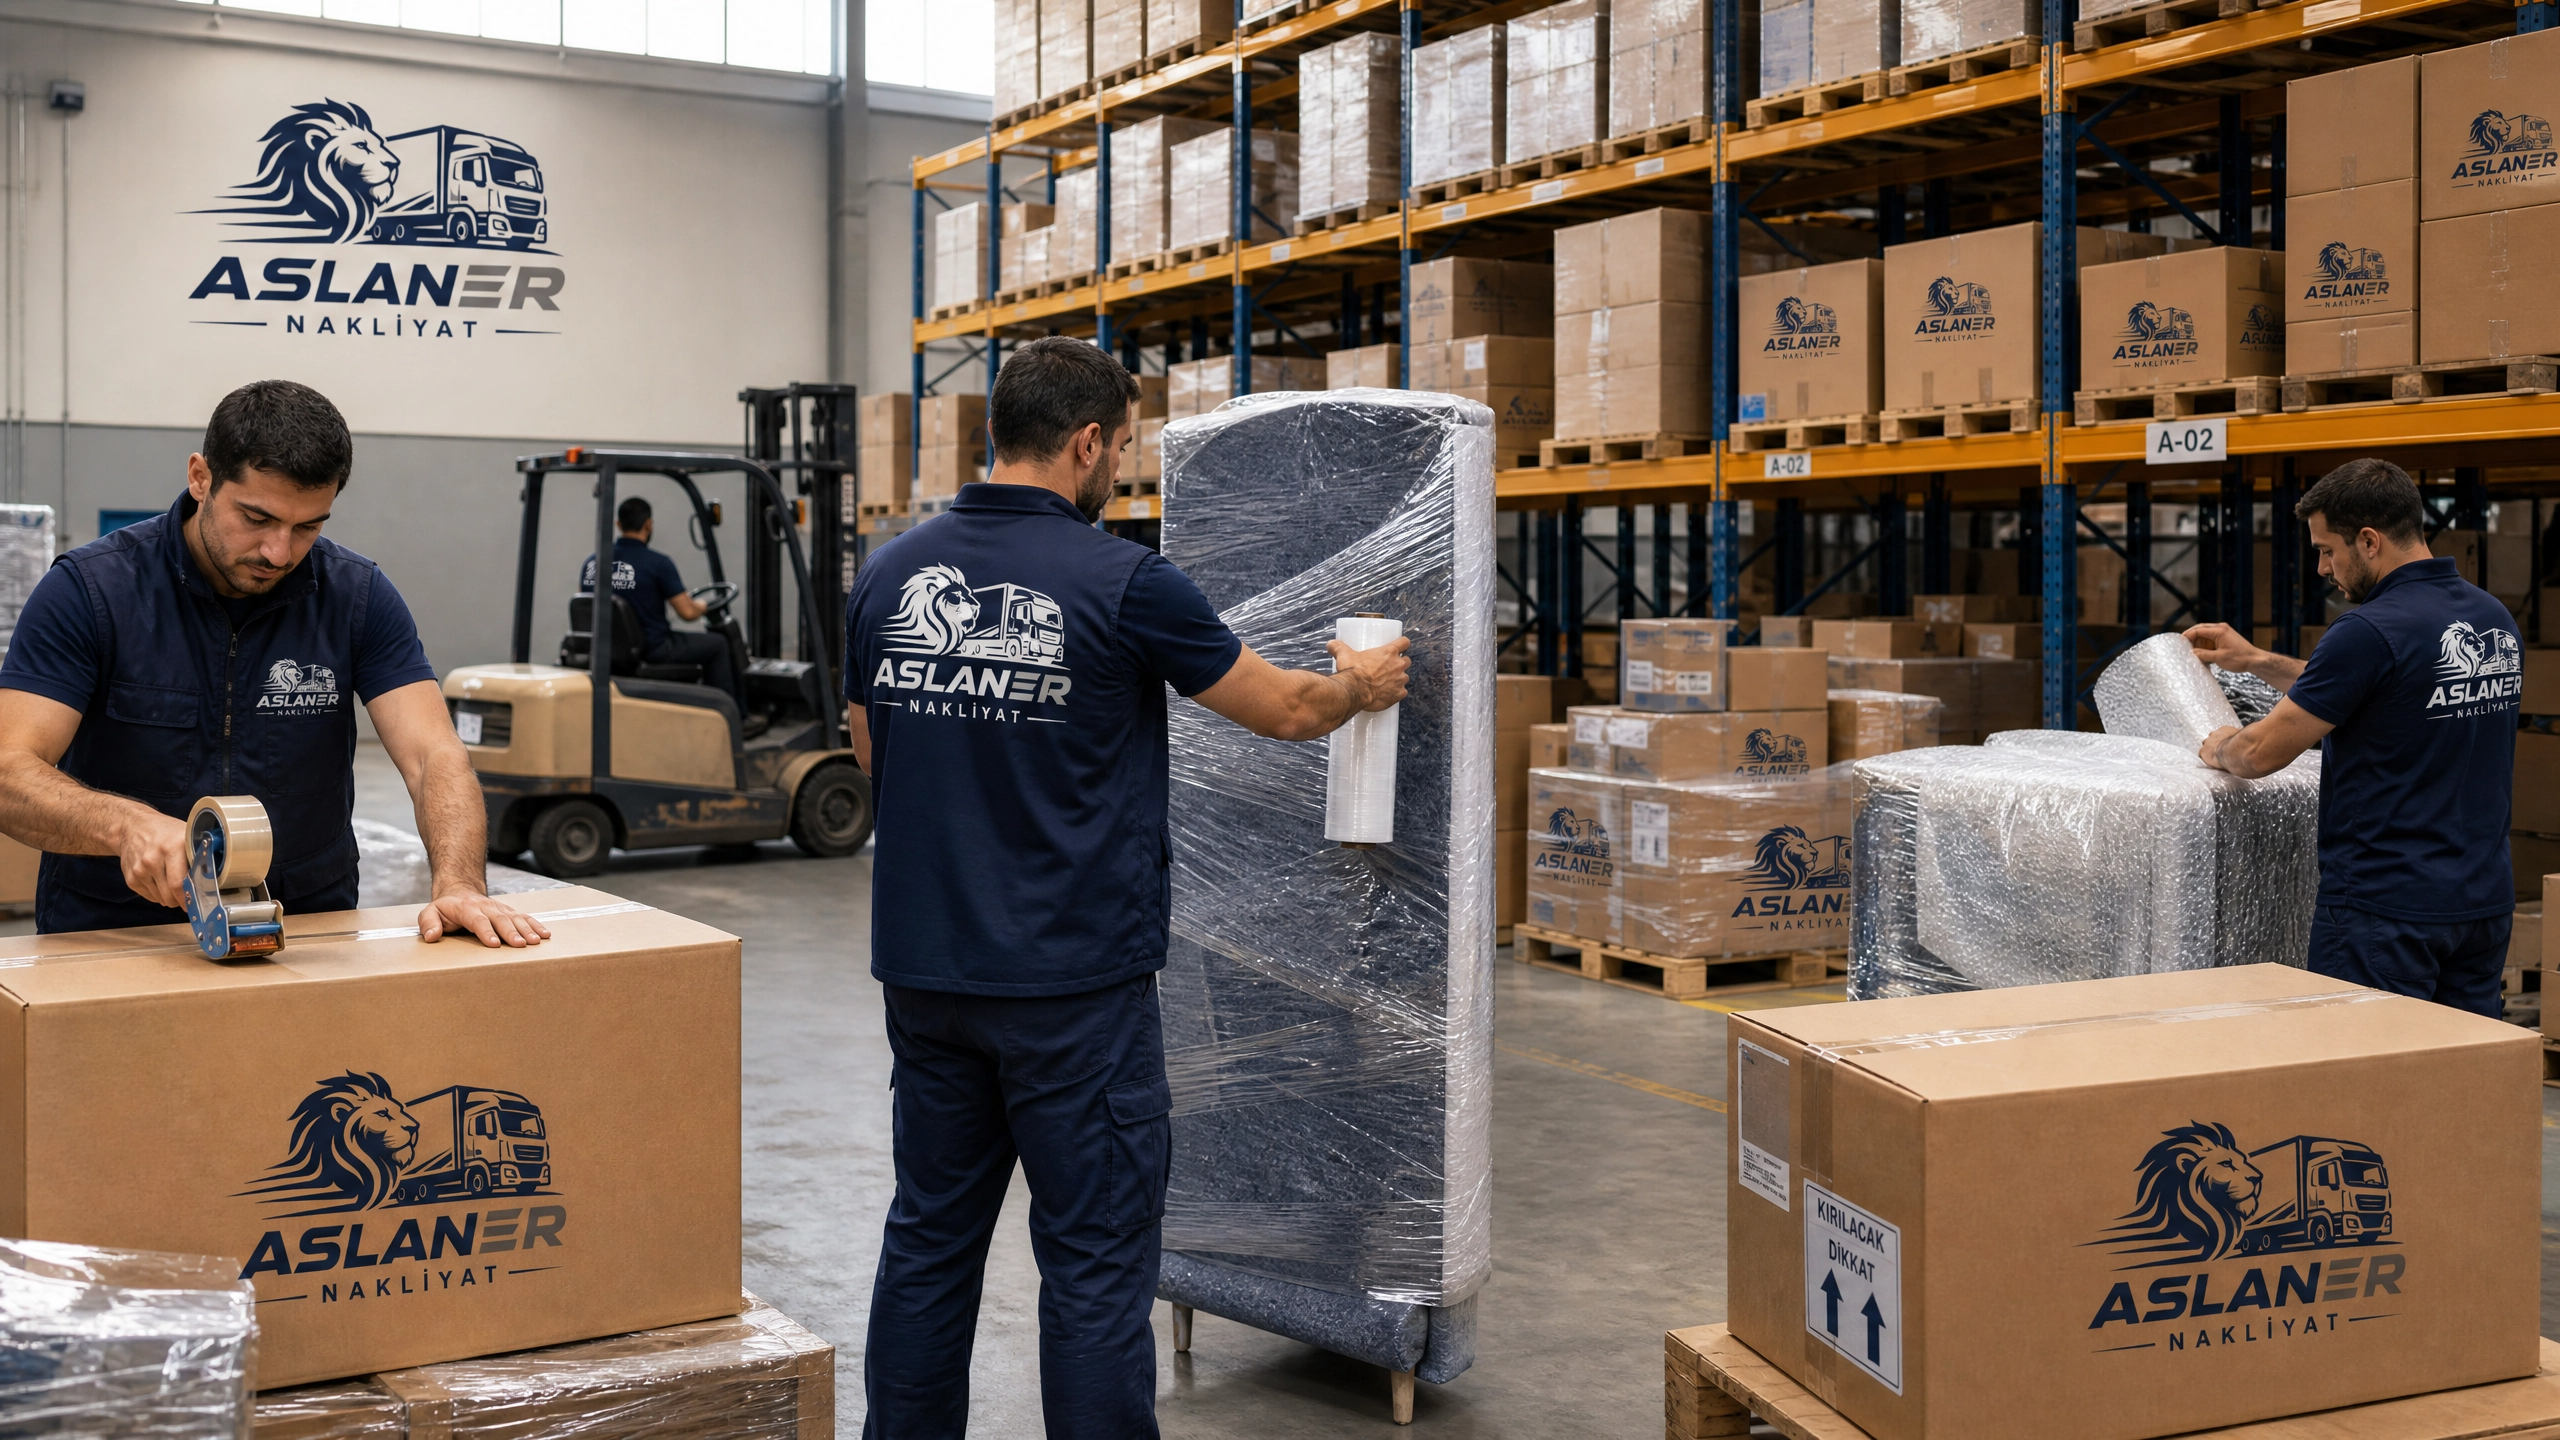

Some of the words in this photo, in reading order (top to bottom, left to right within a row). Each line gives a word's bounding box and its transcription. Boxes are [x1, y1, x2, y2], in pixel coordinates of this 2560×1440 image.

[2451, 152, 2558, 179] ASLANER
[188, 256, 565, 311] ASLANER
[2304, 281, 2389, 300] ASLANER
[287, 314, 477, 338] NAKLİYAT
[1914, 317, 1995, 334] ASLANER
[1763, 336, 1841, 352] ASLANER
[2112, 342, 2198, 360] ASLANER
[2157, 427, 2213, 453] A-02
[1770, 455, 1804, 475] A-02
[873, 658, 1072, 706] ASLANER
[2426, 675, 2522, 709] ASLANER
[256, 693, 339, 708] ASLANER
[909, 699, 1021, 723] NAKLİYAT
[1733, 764, 1810, 779] ASLANER
[1535, 852, 1614, 878] ASLANER
[1818, 1197, 1885, 1254] KIRILACAK
[237, 1205, 567, 1281] ASLANER
[1829, 1238, 1875, 1283] DİKKAT
[322, 1265, 497, 1303] NAKLİYAT
[2088, 1253, 2406, 1330] ASLANER
[2169, 1312, 2338, 1351] NAKLİYAT
